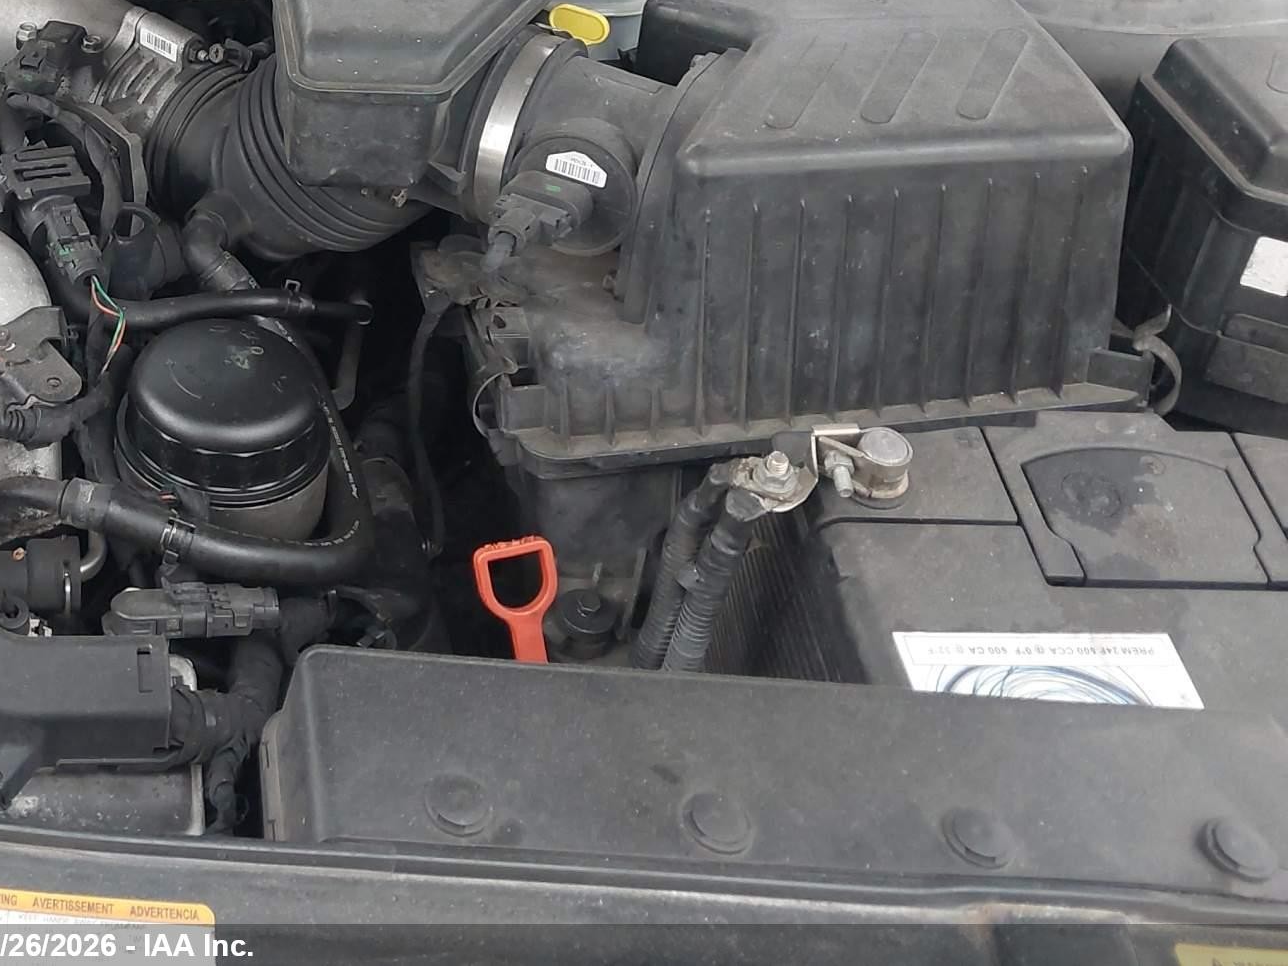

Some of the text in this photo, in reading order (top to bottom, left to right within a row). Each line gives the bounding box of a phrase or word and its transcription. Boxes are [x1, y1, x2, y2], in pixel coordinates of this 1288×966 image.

[967, 645, 985, 655] CA
[1049, 645, 1074, 655] CCA
[32, 897, 114, 915] AVERTISSEMENT
[129, 905, 200, 921] ADVERTENCIA
